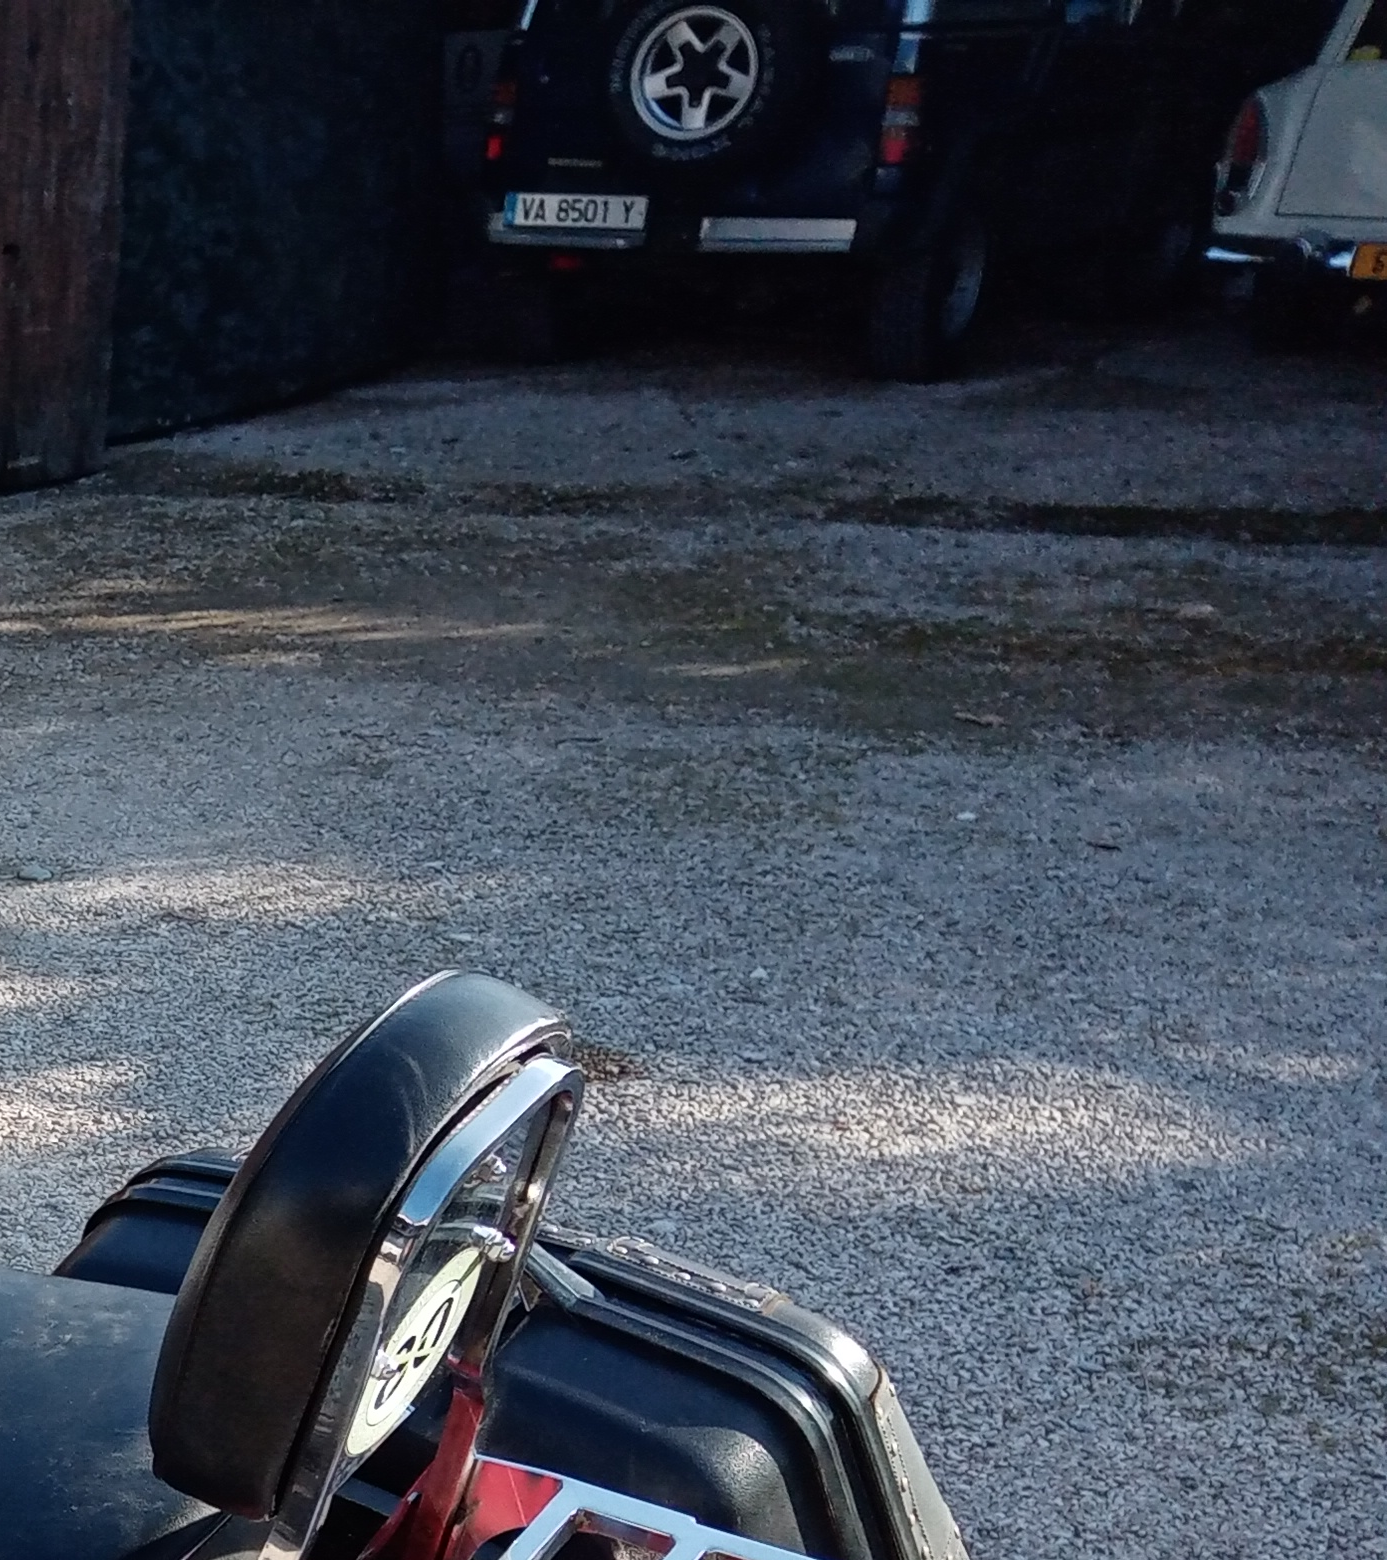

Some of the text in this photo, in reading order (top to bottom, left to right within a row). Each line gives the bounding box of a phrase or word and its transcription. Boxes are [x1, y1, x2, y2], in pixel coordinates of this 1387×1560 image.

[521, 196, 635, 223] VA 8501 Y
